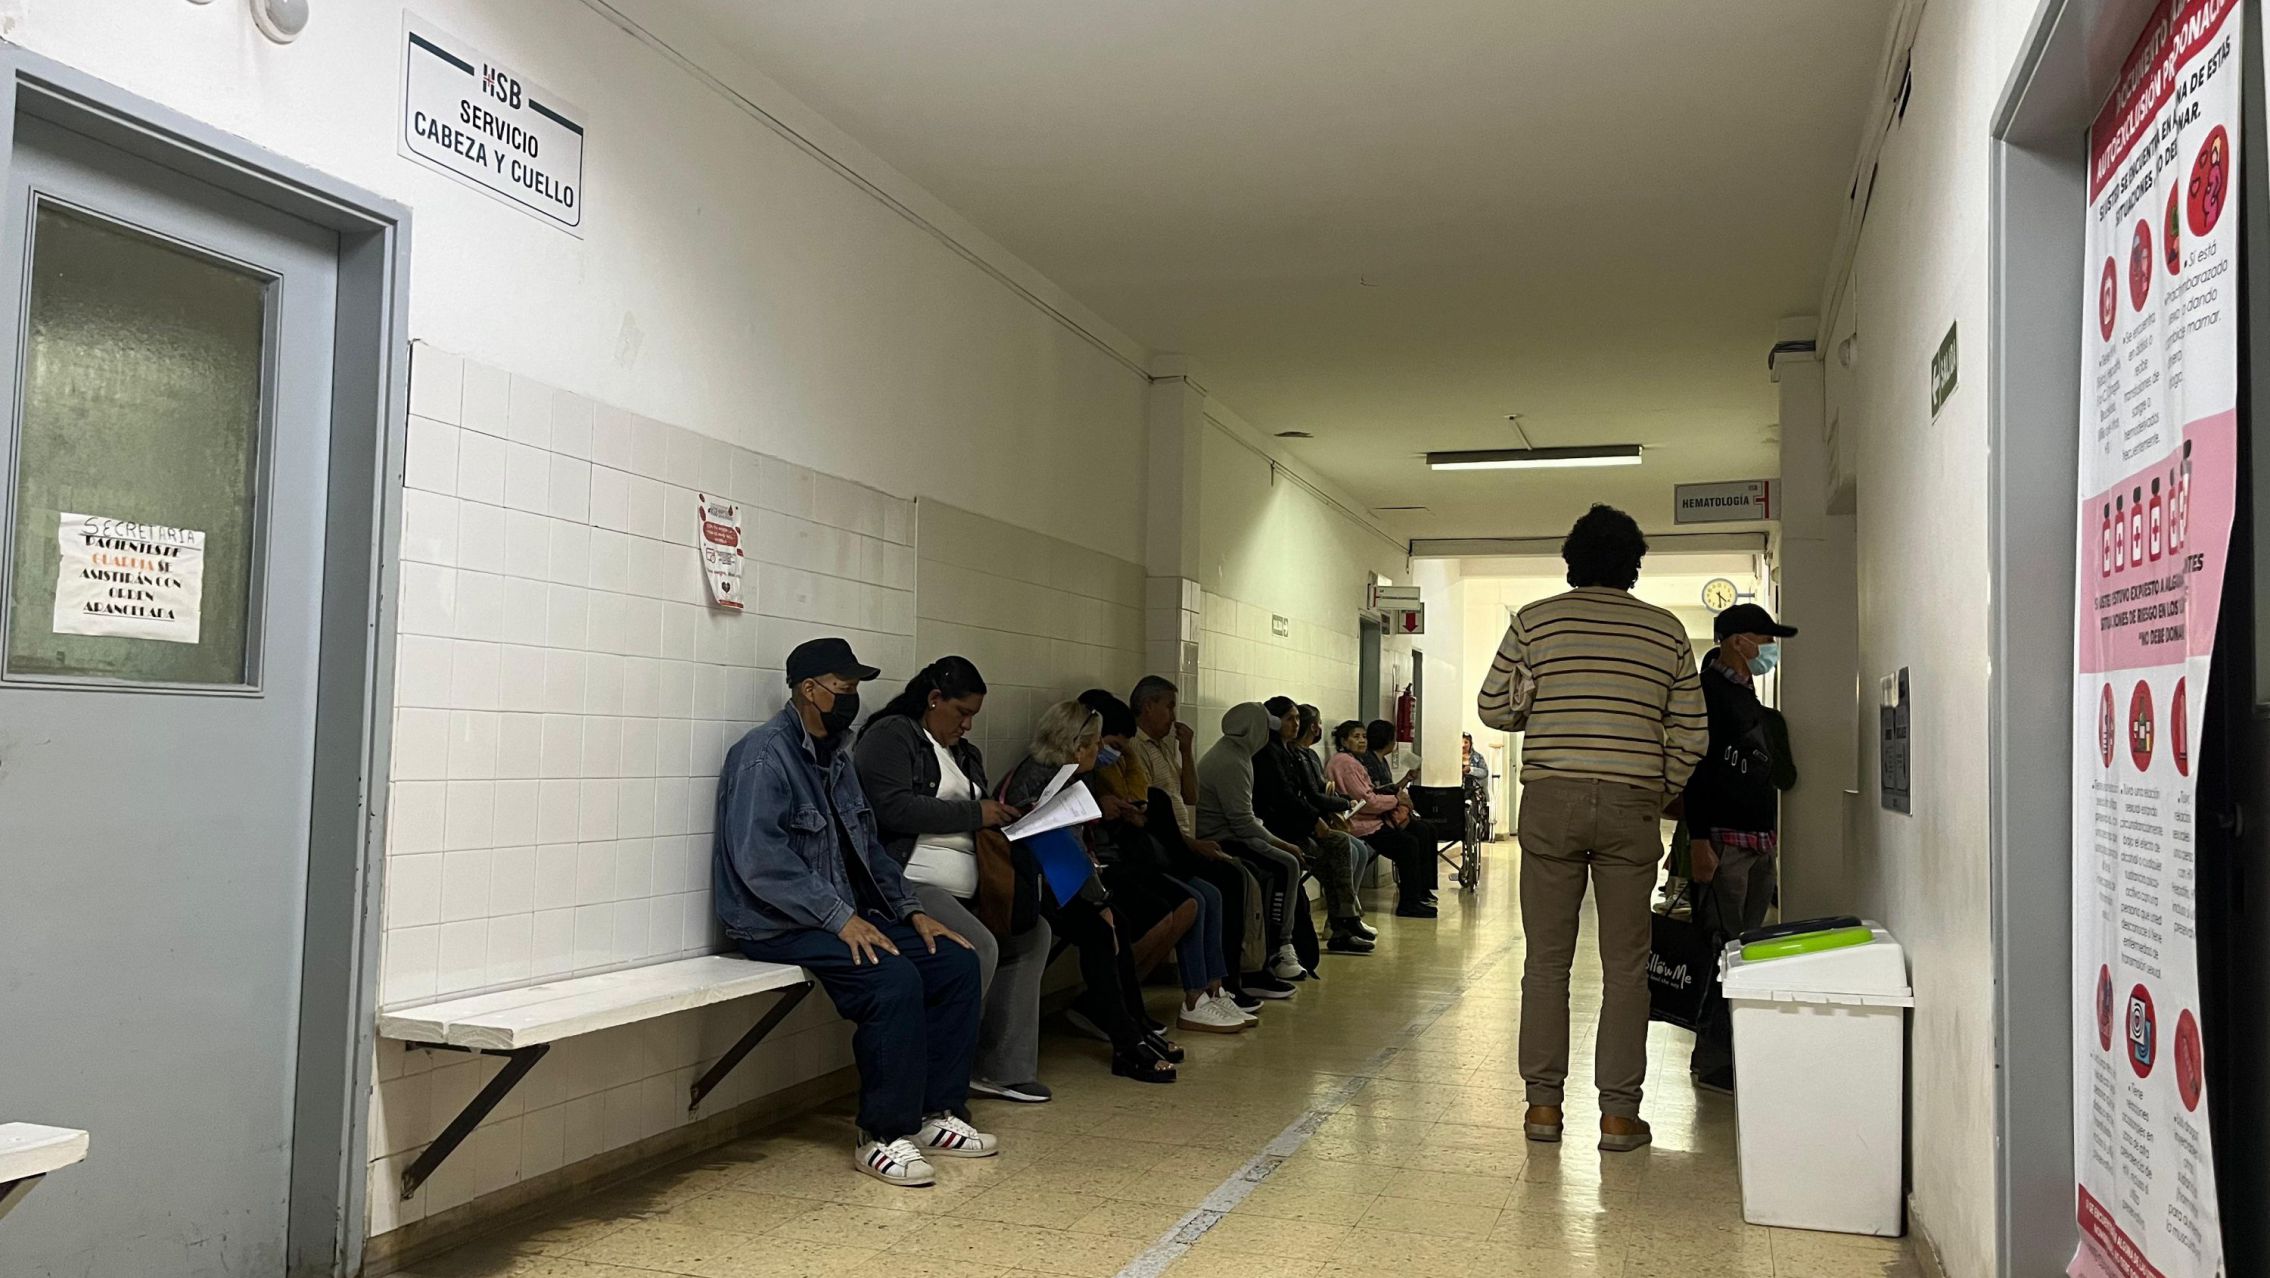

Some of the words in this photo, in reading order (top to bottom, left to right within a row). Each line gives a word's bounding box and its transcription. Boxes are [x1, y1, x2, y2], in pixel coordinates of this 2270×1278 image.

[2190, 65, 2205, 94] DE
[2207, 34, 2231, 81] ESTAS
[482, 63, 522, 110] HSB
[460, 99, 539, 158] SERVICIO
[414, 111, 487, 167] CABEZA
[494, 149, 505, 174] Y
[511, 159, 574, 208] CUELLO
[1682, 494, 1749, 509] HEMATOLOGÍA
[82, 517, 195, 544] SECRETARIA
[85, 535, 161, 556] PACIENTES
[163, 546, 180, 557] DE
[92, 553, 154, 571] GUARDIA
[157, 560, 173, 573] SE
[80, 568, 152, 586] ASISTIRÁN
[156, 577, 181, 588] CON
[109, 587, 154, 601] ORDEN
[83, 601, 175, 619] ARANCELADA
[1672, 963, 1692, 989] Me
